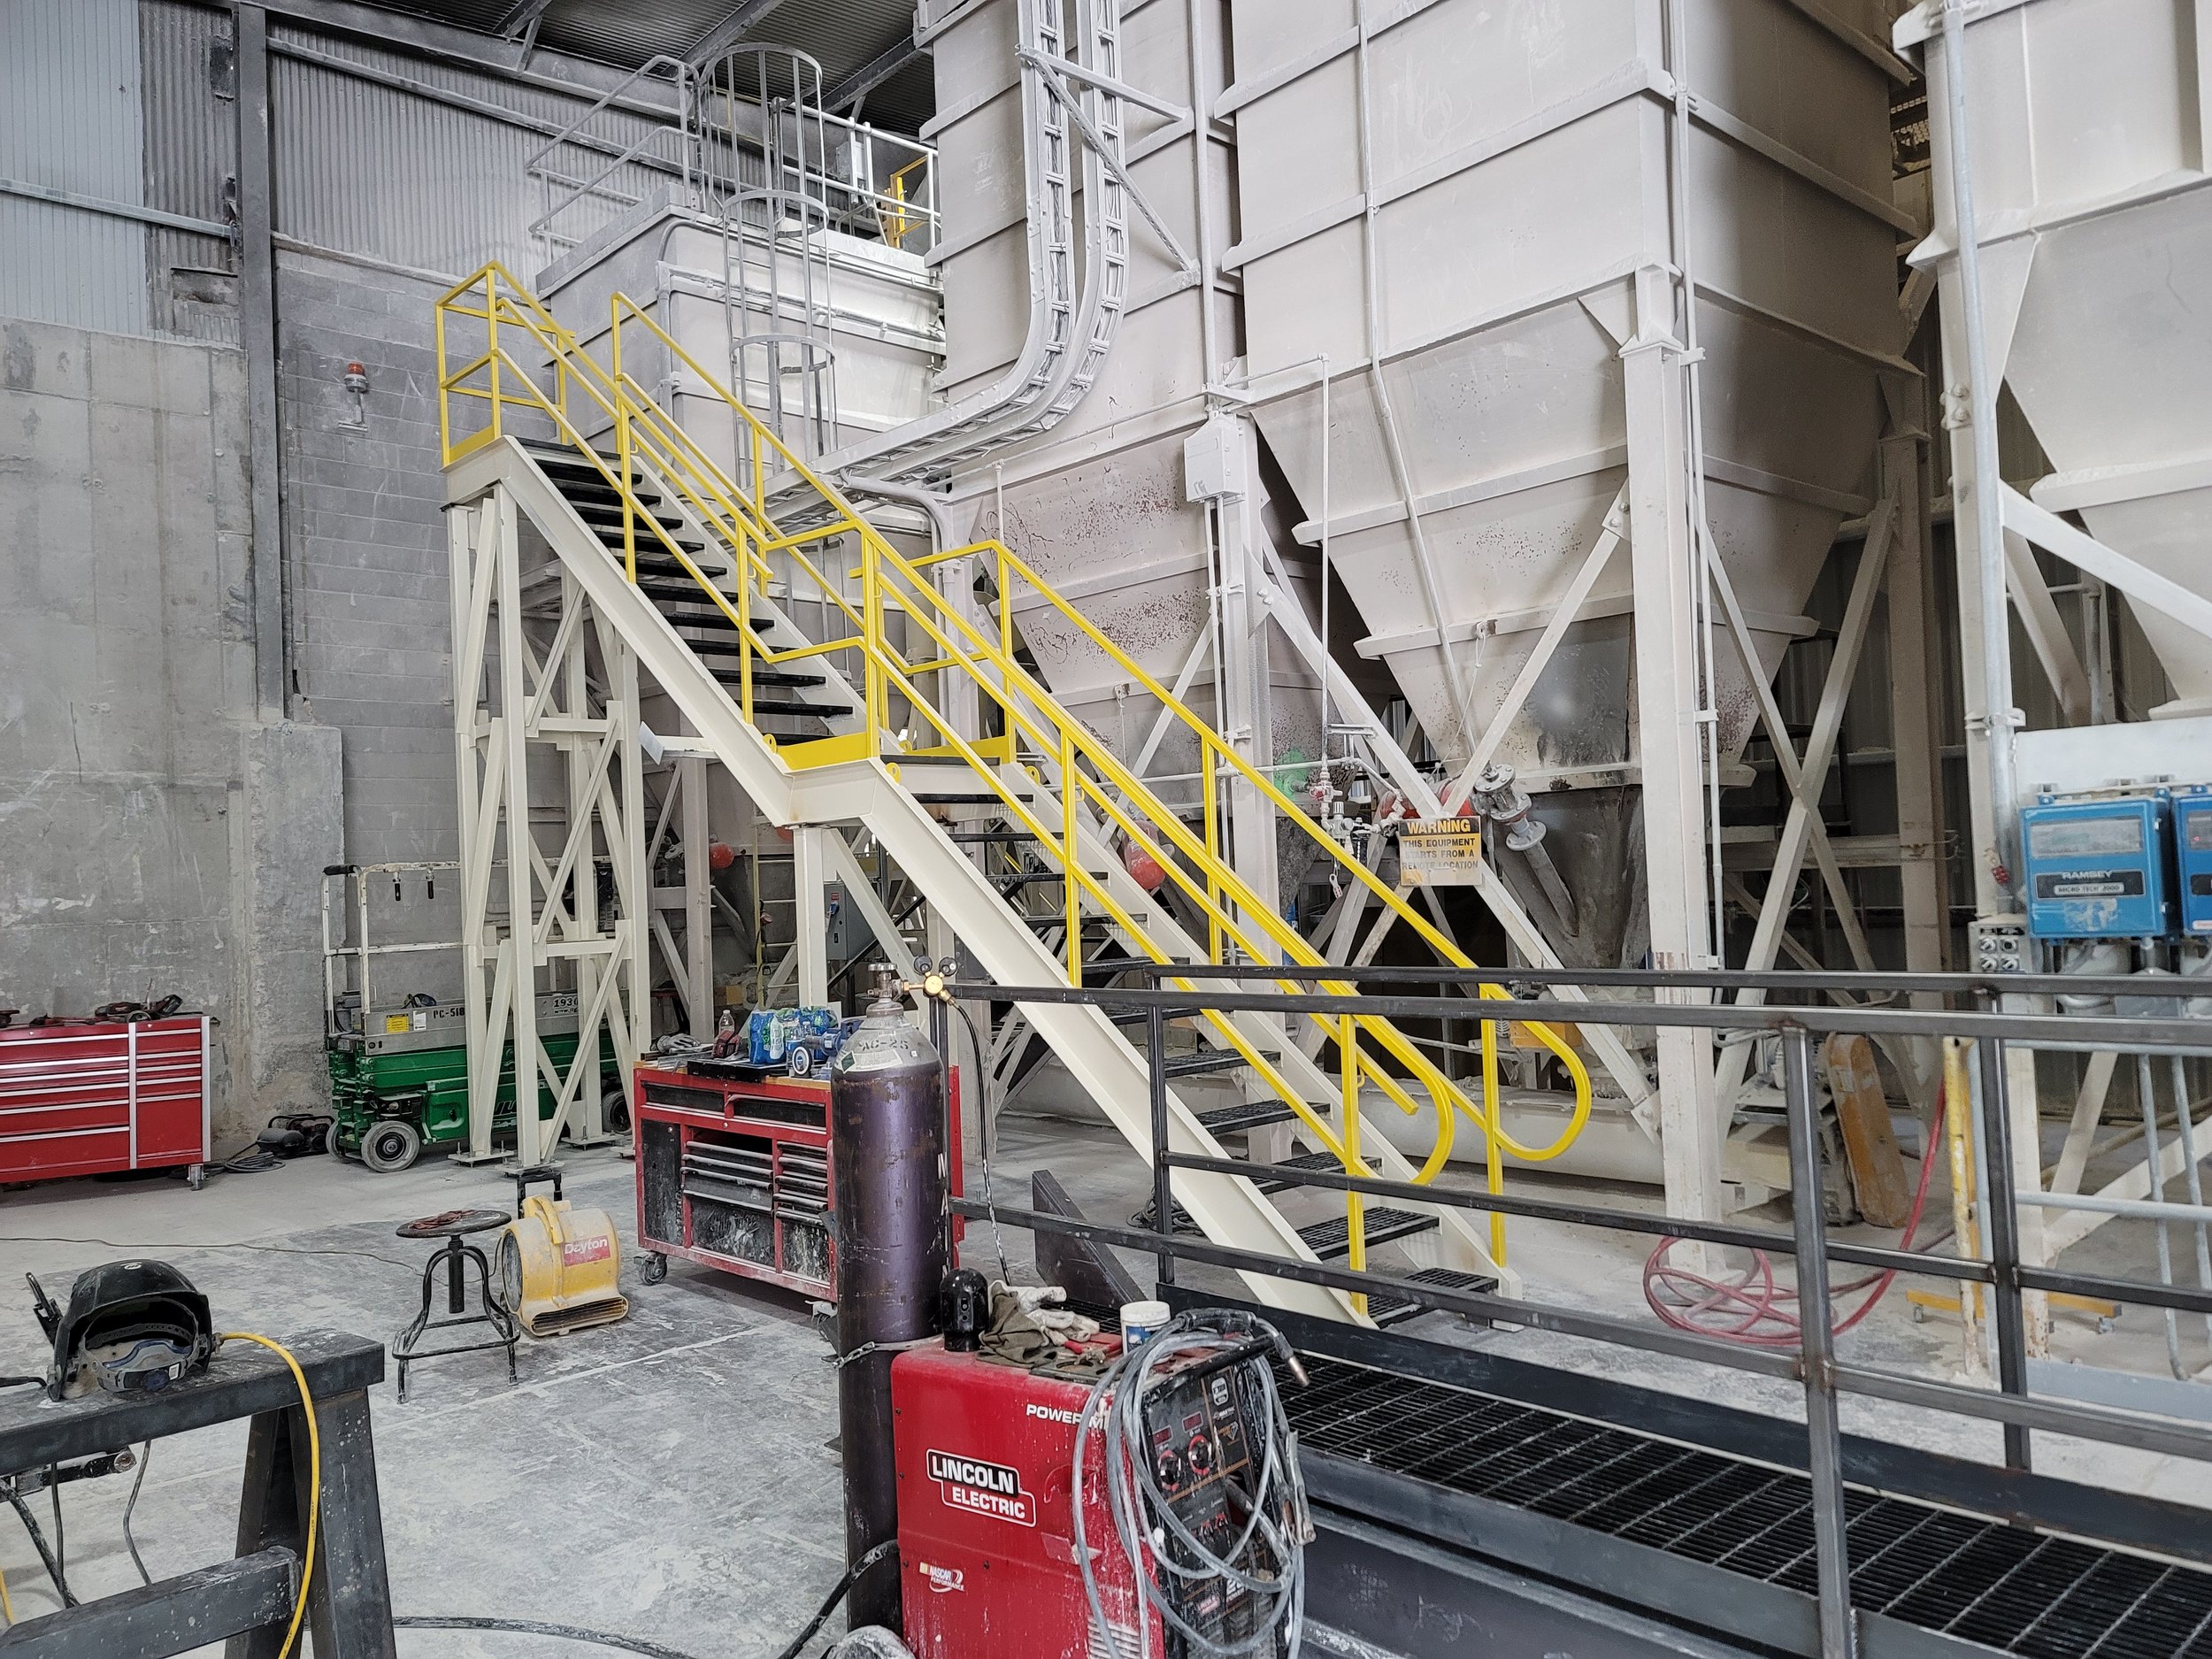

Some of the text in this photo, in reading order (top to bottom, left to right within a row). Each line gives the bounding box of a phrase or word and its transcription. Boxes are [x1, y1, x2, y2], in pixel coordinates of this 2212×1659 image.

[1407, 818, 1471, 834] WARNING
[1403, 838, 1476, 849] THIS EQUIPMENT
[1404, 850, 1437, 859] STARTS
[1441, 849, 1465, 858] FROM
[1439, 861, 1479, 870] LOCATION
[2062, 870, 2113, 879] RAMSEY
[565, 1239, 608, 1254] Dayton
[932, 1455, 1014, 1494] LINCOLN
[952, 1486, 1025, 1519] ELECTRIC
[930, 1565, 953, 1581] NASCAR
